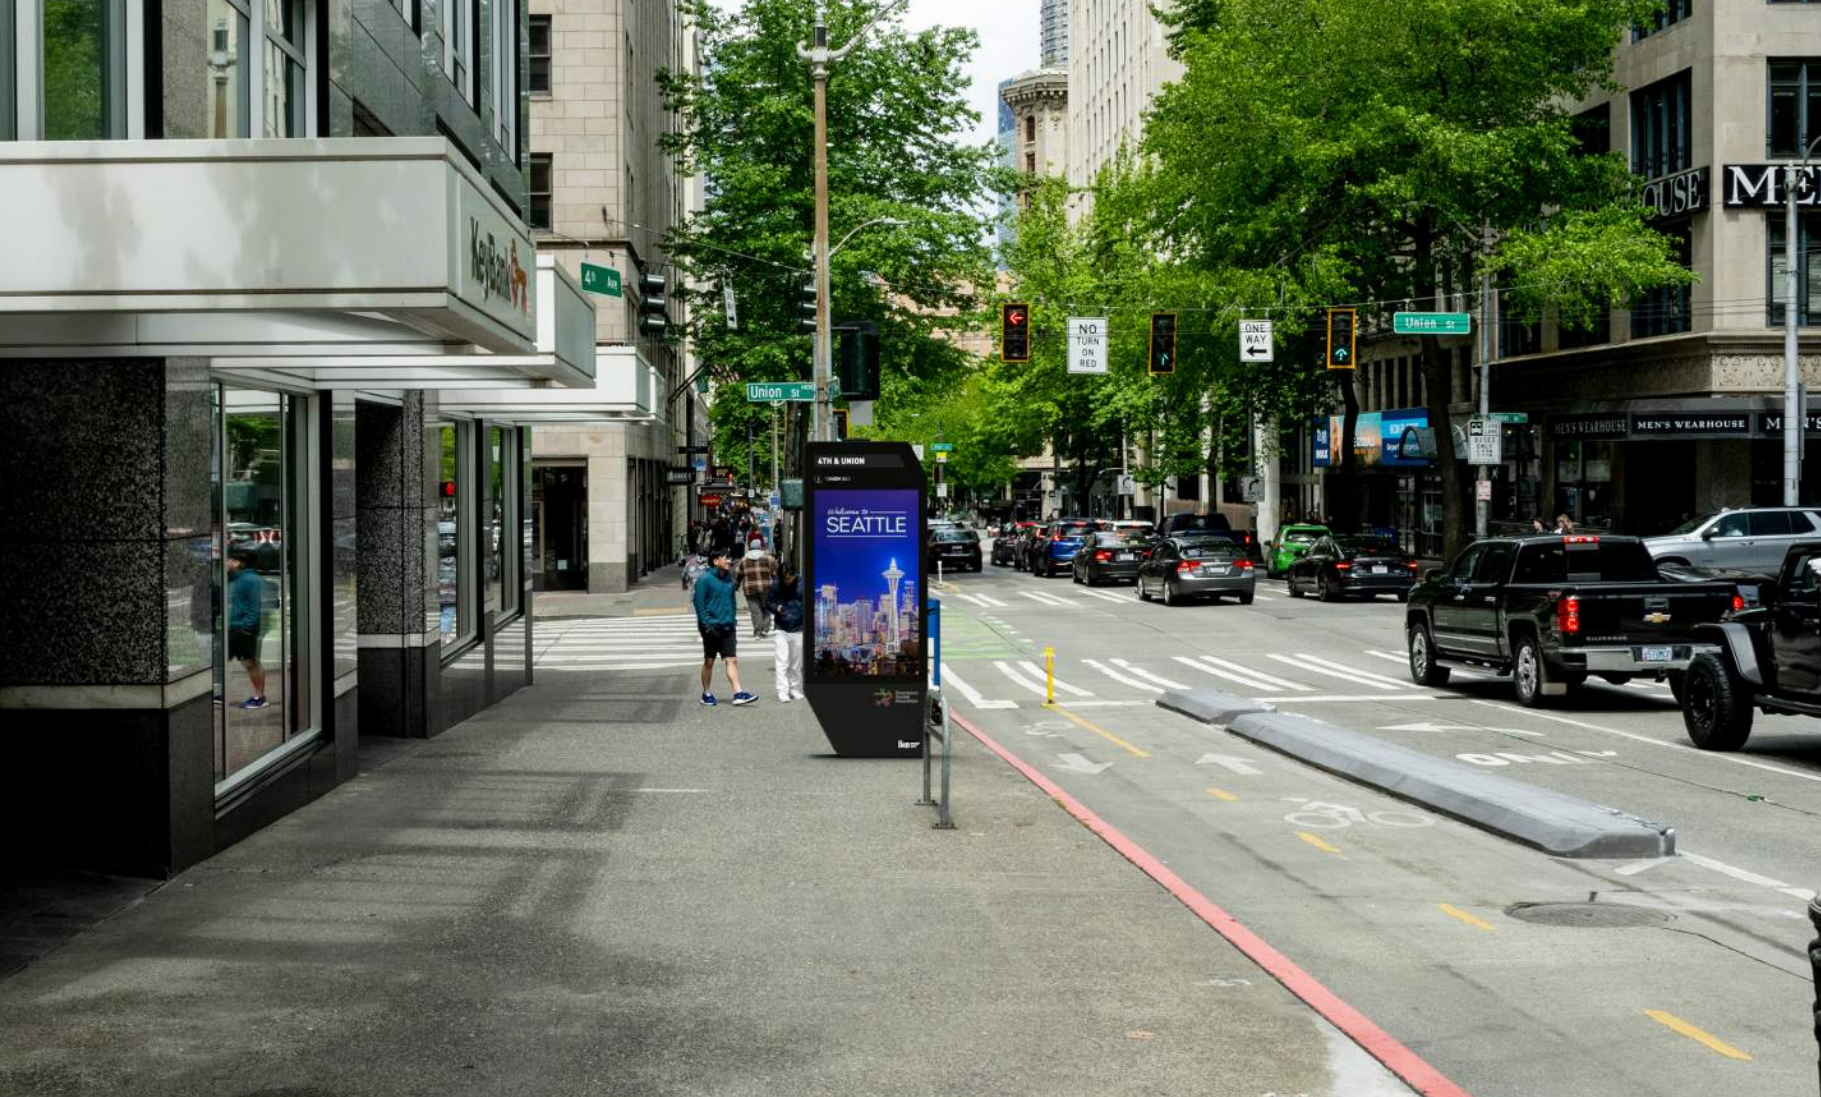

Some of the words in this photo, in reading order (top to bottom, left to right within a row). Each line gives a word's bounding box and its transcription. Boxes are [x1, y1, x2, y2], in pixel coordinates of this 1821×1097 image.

[1728, 166, 1821, 206] ME
[470, 216, 512, 303] KeyBank
[1245, 324, 1266, 333] ONE
[1405, 317, 1437, 329] Union
[1079, 324, 1097, 335] NO
[1077, 336, 1100, 346] TURN
[1245, 334, 1267, 344] WAY
[1082, 348, 1095, 356] ON
[1079, 359, 1097, 368] RED
[750, 385, 782, 399] Union
[791, 388, 800, 398] St
[1554, 422, 1577, 434] MEN'S
[1578, 419, 1627, 433] WEARHOUSE
[1637, 420, 1672, 430] MEN'S
[1675, 419, 1746, 429] WEARHOUSE
[817, 457, 832, 465] 4TH
[833, 457, 840, 465] &
[841, 457, 866, 465] UNION
[826, 516, 907, 533] SEATTLE
[1455, 751, 1619, 766] ONLY
